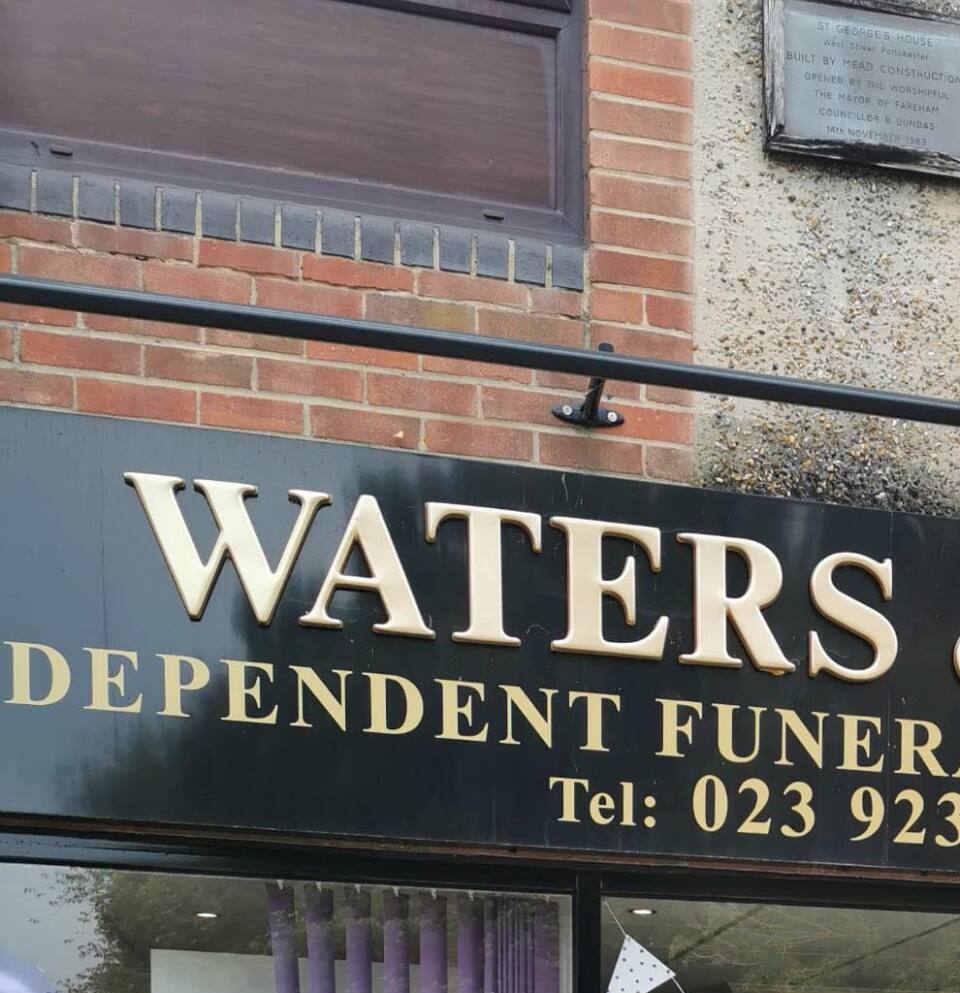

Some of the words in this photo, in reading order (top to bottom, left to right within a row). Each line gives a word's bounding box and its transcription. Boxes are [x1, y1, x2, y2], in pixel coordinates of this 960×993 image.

[897, 33, 934, 48] HOUSE
[786, 51, 816, 64] BUILT
[822, 55, 837, 66] BY
[843, 57, 874, 72] MEAD
[804, 71, 844, 85] OPENED
[890, 84, 951, 100] WORSHIPFUL
[815, 89, 833, 100] THE
[838, 92, 872, 105] MAYOR
[877, 96, 890, 107] OF
[895, 100, 940, 115] FAREHAM
[819, 107, 880, 124] COUNCILLOR
[896, 117, 936, 132] DUNDAS
[847, 127, 900, 142] NOVEMBER
[123, 471, 898, 684] WATERS
[549, 775, 658, 829] Tel:
[692, 774, 816, 839] 023
